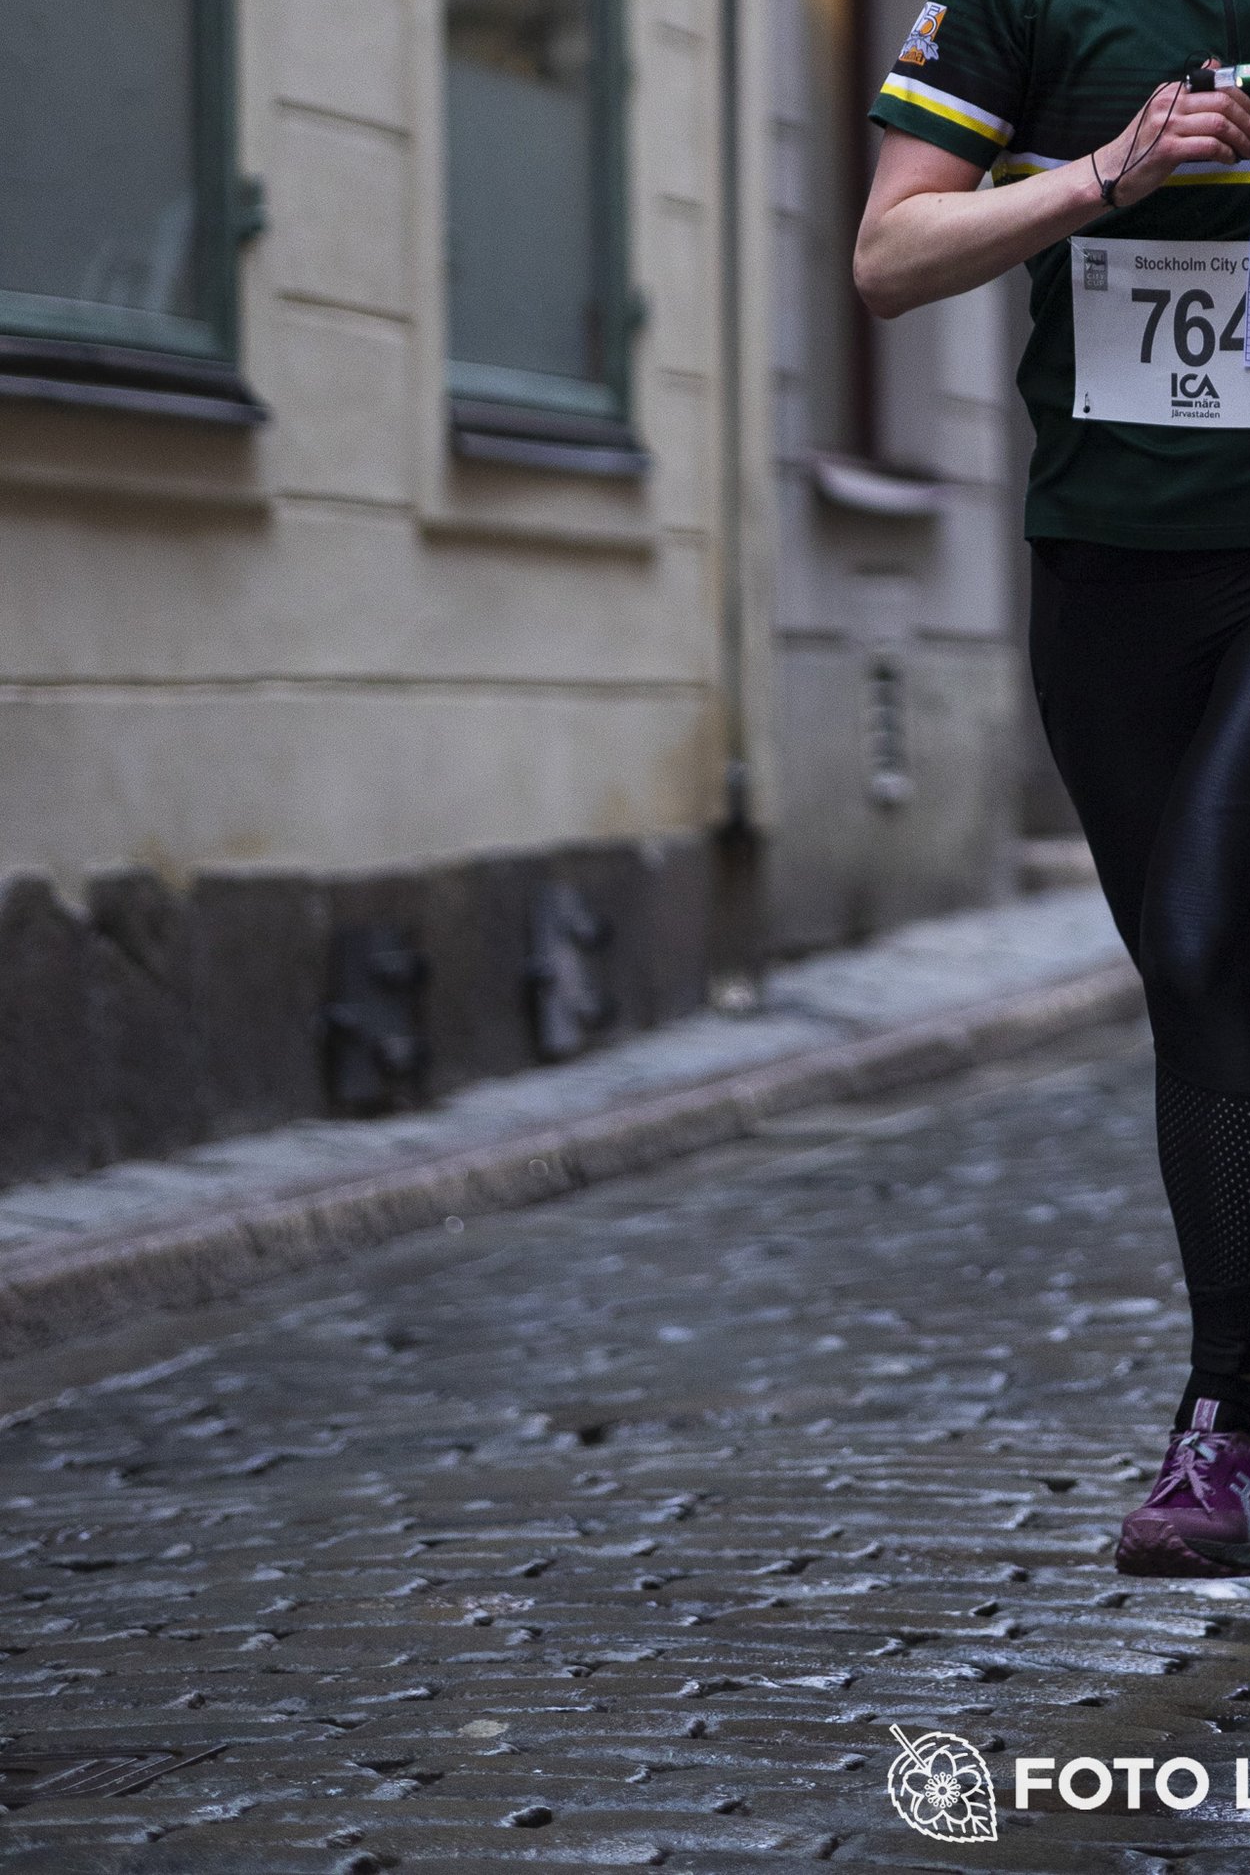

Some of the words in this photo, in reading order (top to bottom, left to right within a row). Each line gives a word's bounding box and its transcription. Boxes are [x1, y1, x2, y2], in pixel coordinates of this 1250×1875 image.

[1135, 255, 1206, 272] Stockholm
[1210, 257, 1237, 274] City
[1171, 372, 1220, 399] ICA
[1194, 398, 1220, 409] nära
[1171, 409, 1221, 418] Järvastaden
